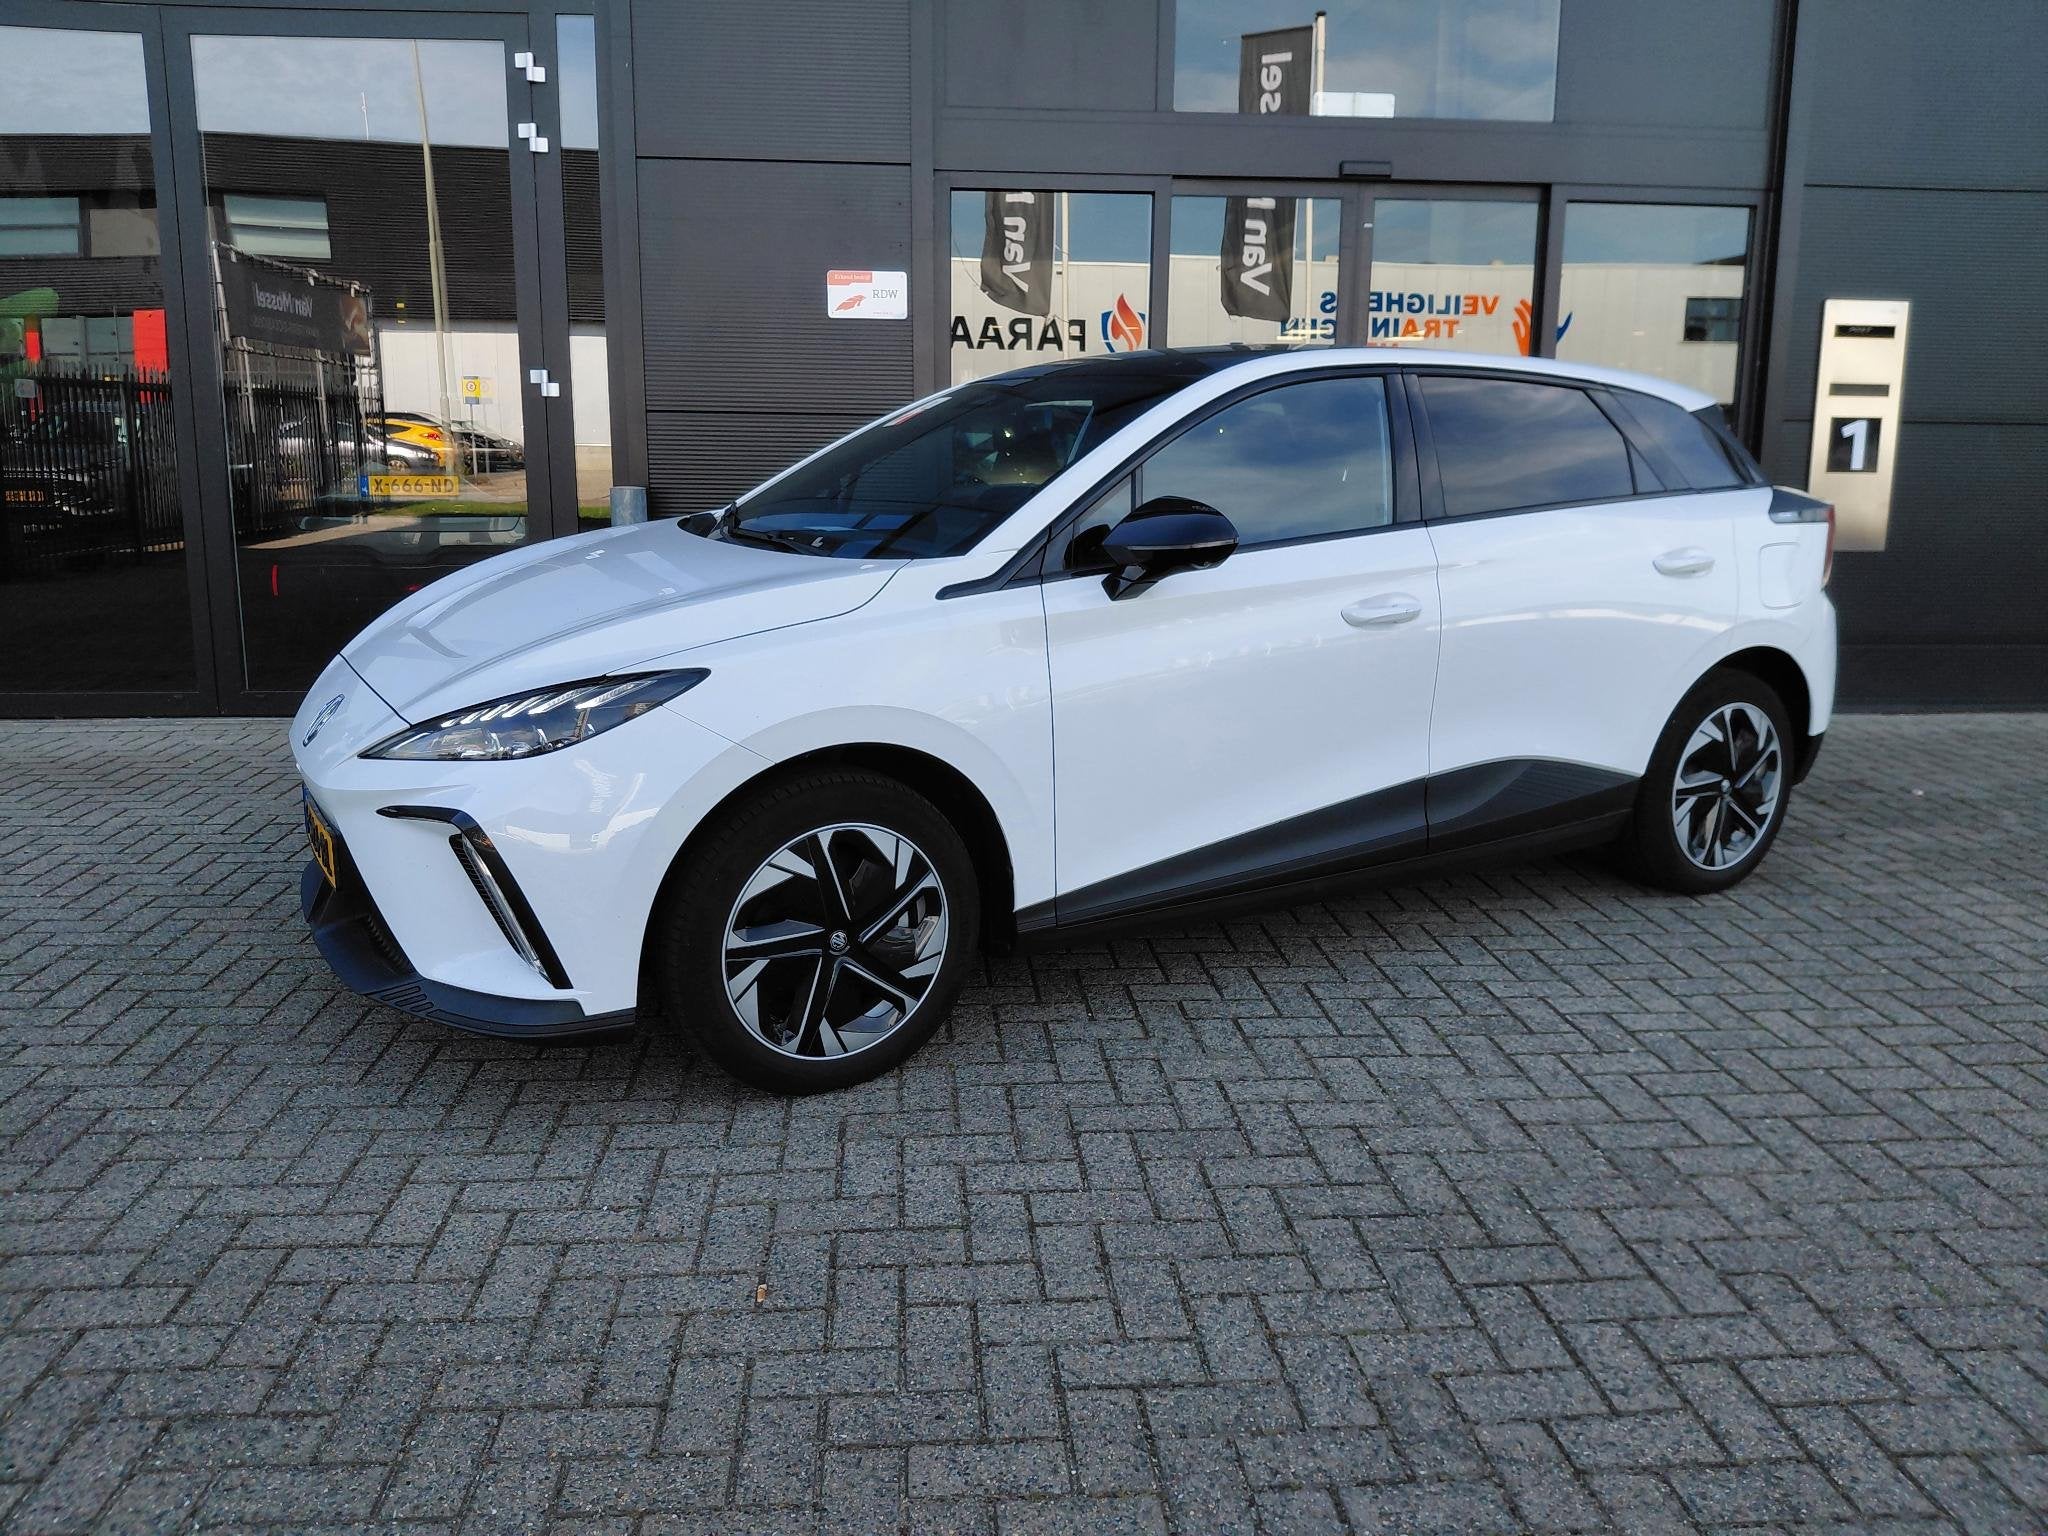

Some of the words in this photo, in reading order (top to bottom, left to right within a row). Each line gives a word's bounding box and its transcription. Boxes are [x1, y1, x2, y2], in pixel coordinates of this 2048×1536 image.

[872, 289, 898, 299] RDW
[1840, 419, 1869, 471] 1
[374, 477, 455, 494] X-666-ND
